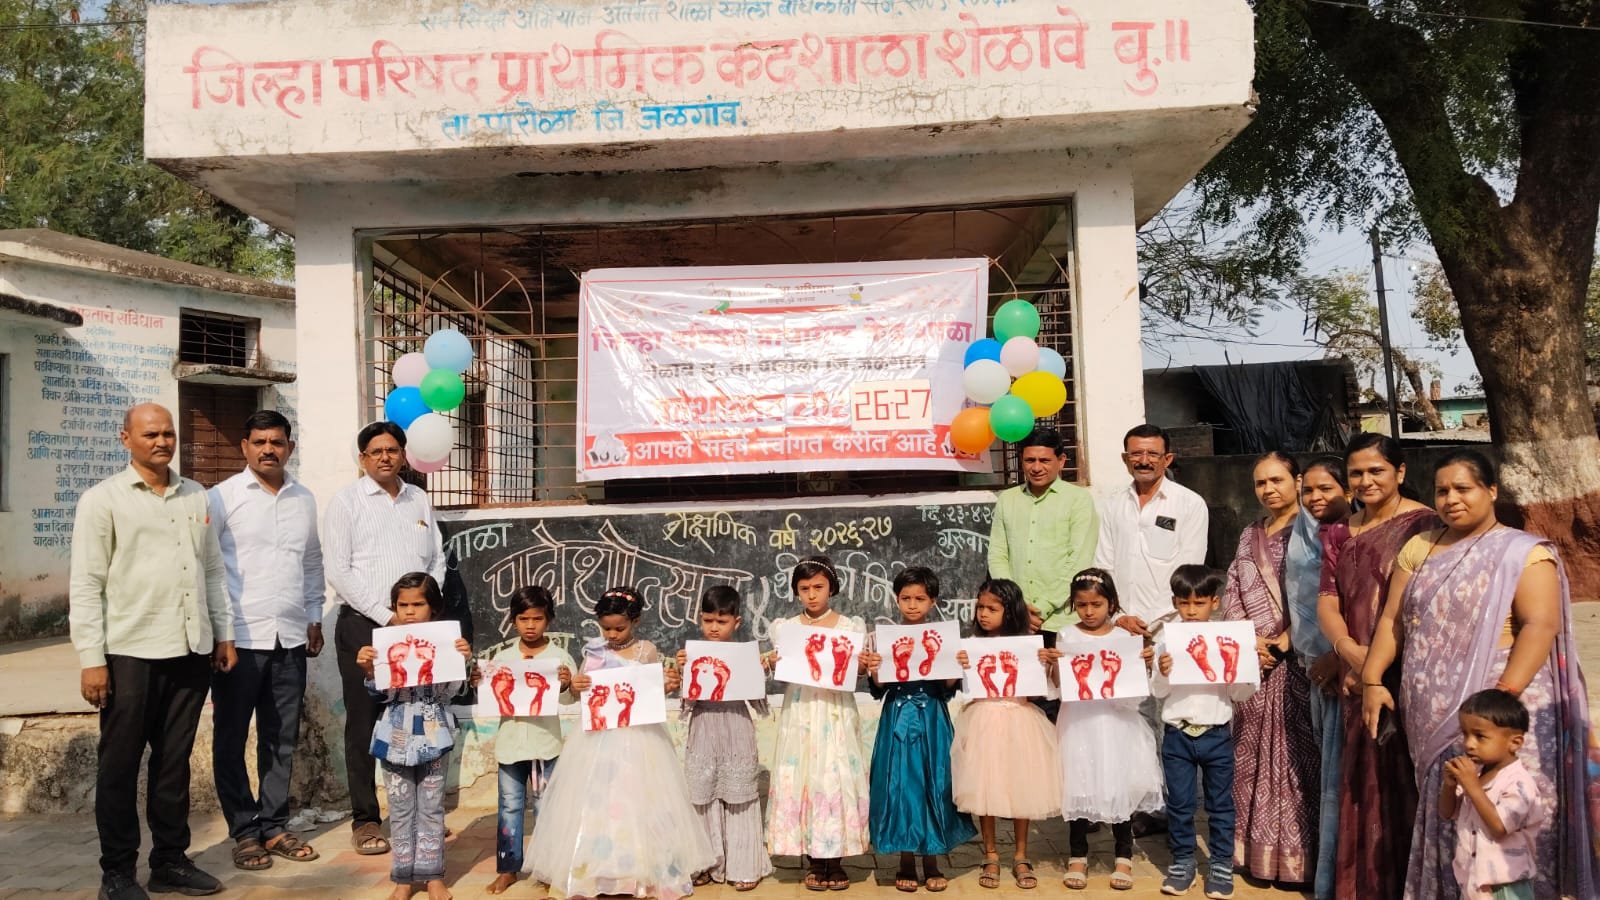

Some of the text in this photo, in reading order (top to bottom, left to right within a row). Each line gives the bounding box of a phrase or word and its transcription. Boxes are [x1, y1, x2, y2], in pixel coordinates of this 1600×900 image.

[182, 44, 323, 119] जिल्हा
[333, 39, 479, 103] परिषद
[492, 29, 704, 104] प्राथमिक
[934, 6, 1090, 78] शेळावे
[632, 434, 693, 461] आपले
[831, 428, 889, 454] करीत
[895, 426, 937, 456] आहे
[768, 513, 803, 550] वर्ष
